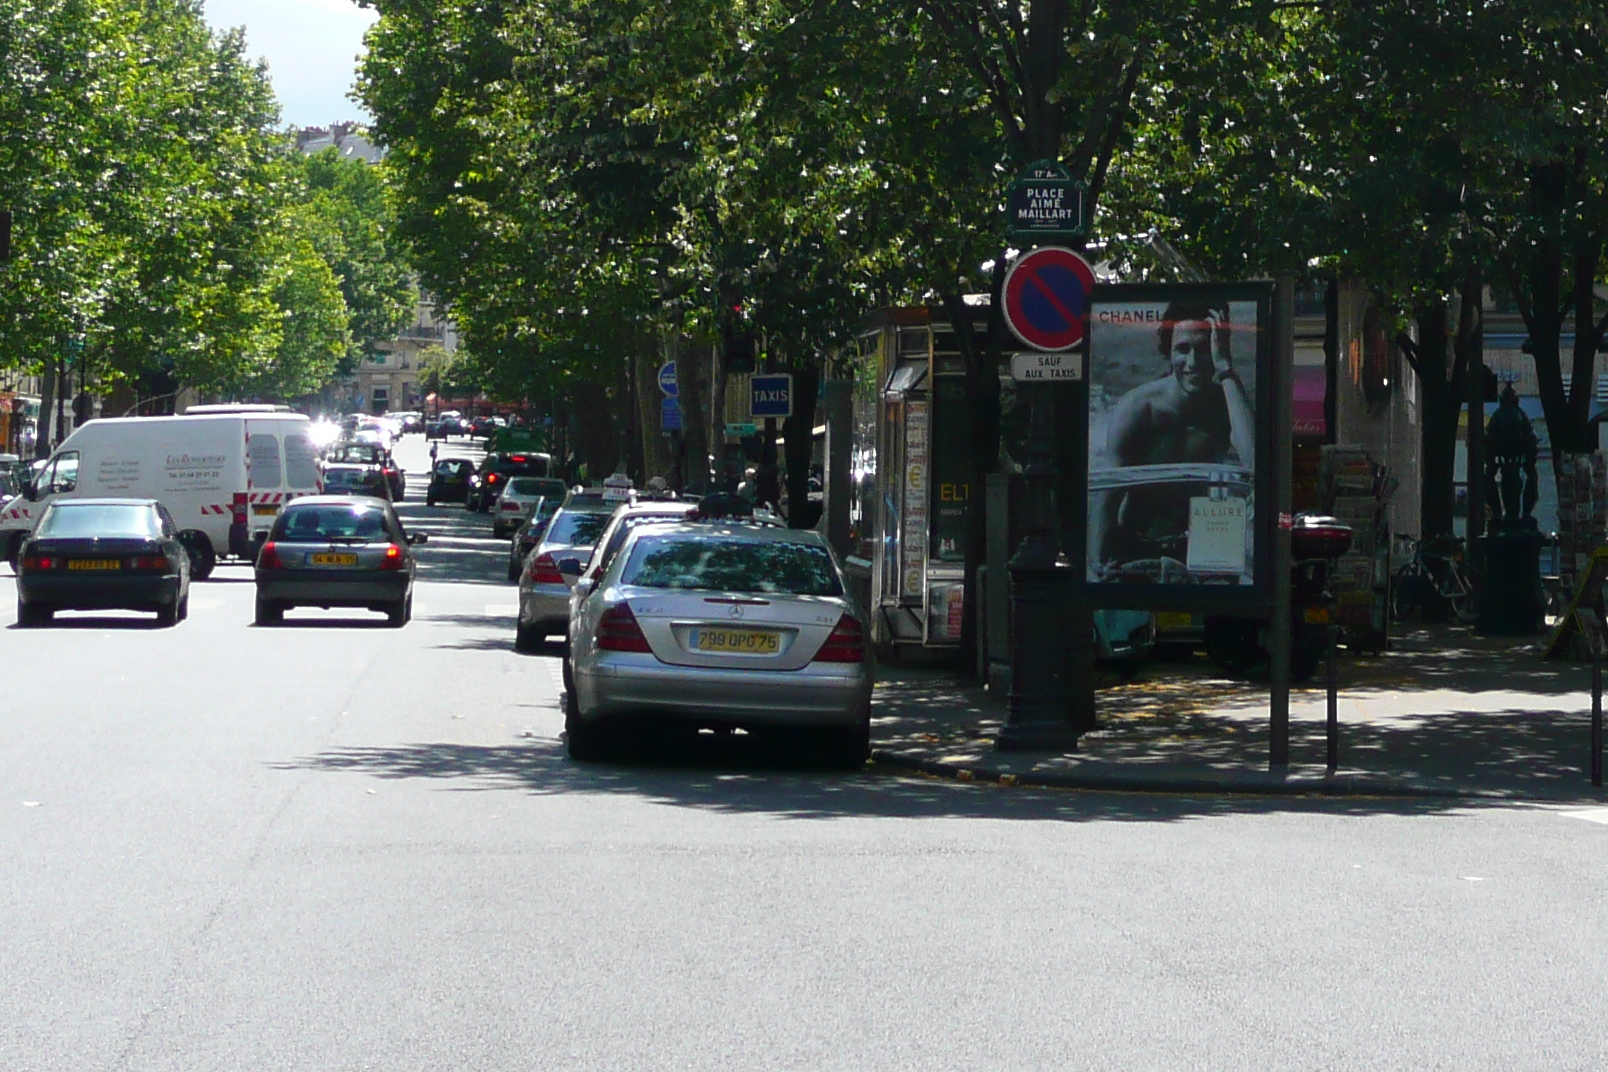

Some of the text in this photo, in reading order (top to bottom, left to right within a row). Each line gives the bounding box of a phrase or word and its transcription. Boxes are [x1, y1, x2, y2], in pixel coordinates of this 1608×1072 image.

[1027, 188, 1065, 198] PLACE
[1030, 198, 1061, 209] AIMÉ
[1018, 209, 1073, 219] MAILLART
[1099, 310, 1164, 323] CHANEL
[1038, 355, 1063, 366] SAUF
[1025, 369, 1076, 378] AUX TAXIS
[753, 389, 789, 403] TAXIS
[1194, 508, 1242, 517] ALLURE
[759, 633, 777, 650] 75
